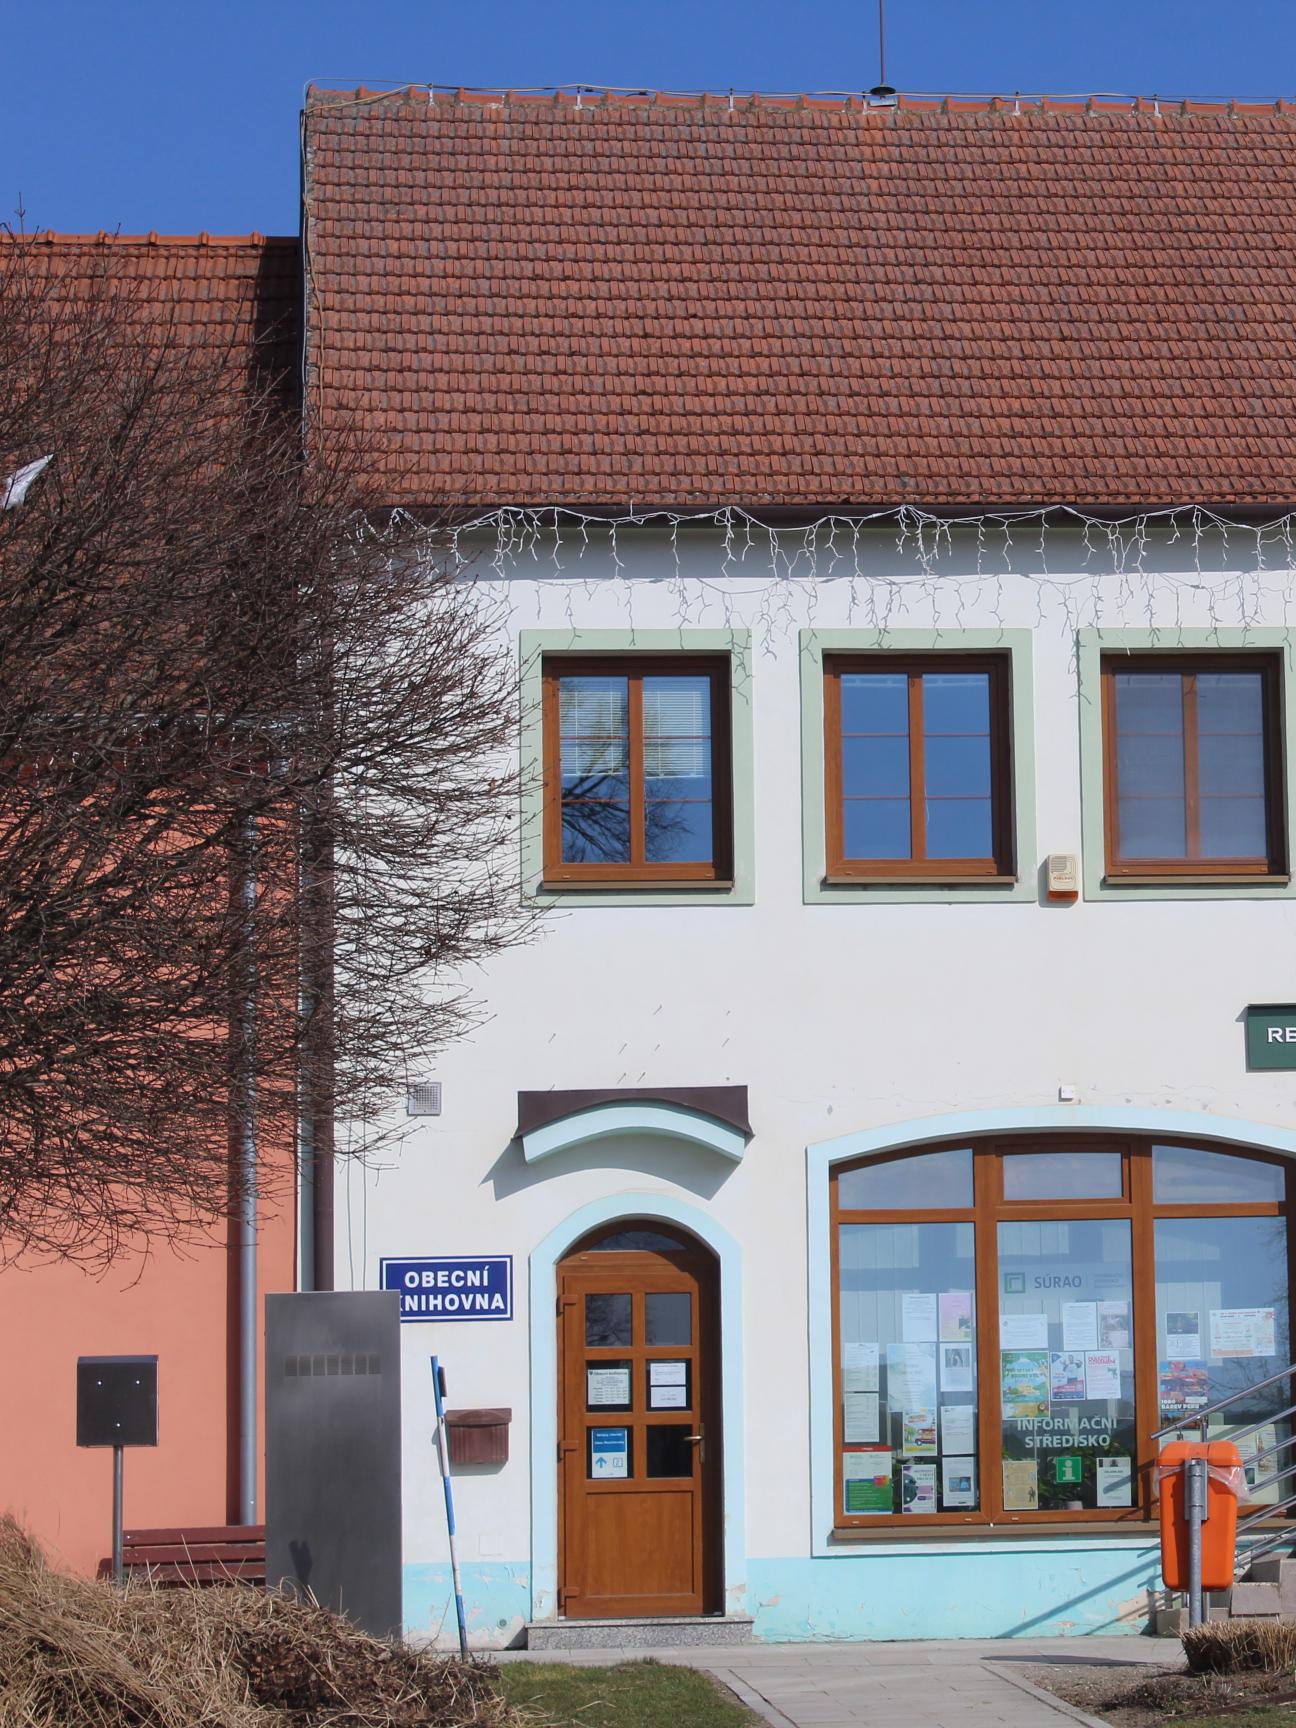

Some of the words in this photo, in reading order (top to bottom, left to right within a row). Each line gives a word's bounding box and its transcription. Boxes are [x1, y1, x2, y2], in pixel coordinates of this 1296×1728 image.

[404, 1265, 490, 1288] OBECNÍ
[1034, 1273, 1083, 1289] SÚRAO
[400, 1292, 506, 1312] NIHOVNA
[1025, 1434, 1111, 1449] STŘEDISKO
